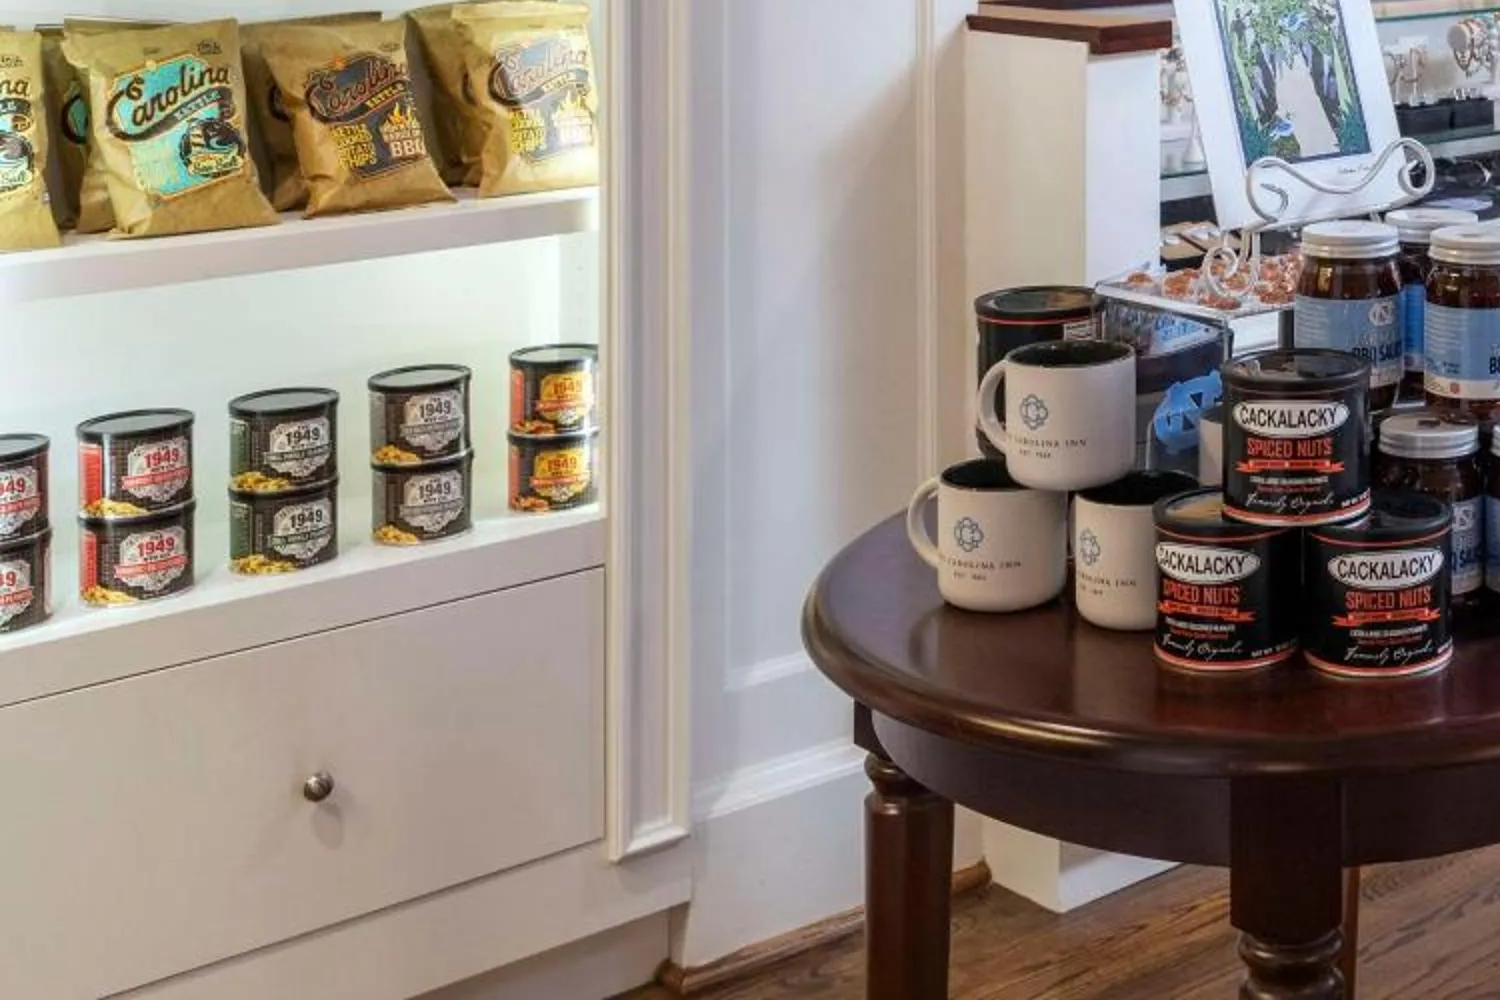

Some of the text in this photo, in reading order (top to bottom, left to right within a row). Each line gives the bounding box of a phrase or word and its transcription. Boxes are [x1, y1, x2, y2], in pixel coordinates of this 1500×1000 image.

[106, 63, 230, 142] Carolina
[420, 399, 451, 420] 1949
[1239, 406, 1337, 428] CACKALACKY
[285, 426, 321, 446] 1949
[1065, 439, 1087, 449] INN
[143, 447, 180, 469] 1949
[1247, 437, 1333, 458] SPICED NUTS
[419, 481, 451, 499] 1949
[289, 509, 323, 529] 1949
[135, 535, 176, 559] 1949
[1158, 546, 1246, 575] CACKALACKY
[1336, 553, 1436, 581] CACKALACKY
[1203, 586, 1240, 605] NUTS
[1344, 584, 1432, 610] SPICED NUTS
